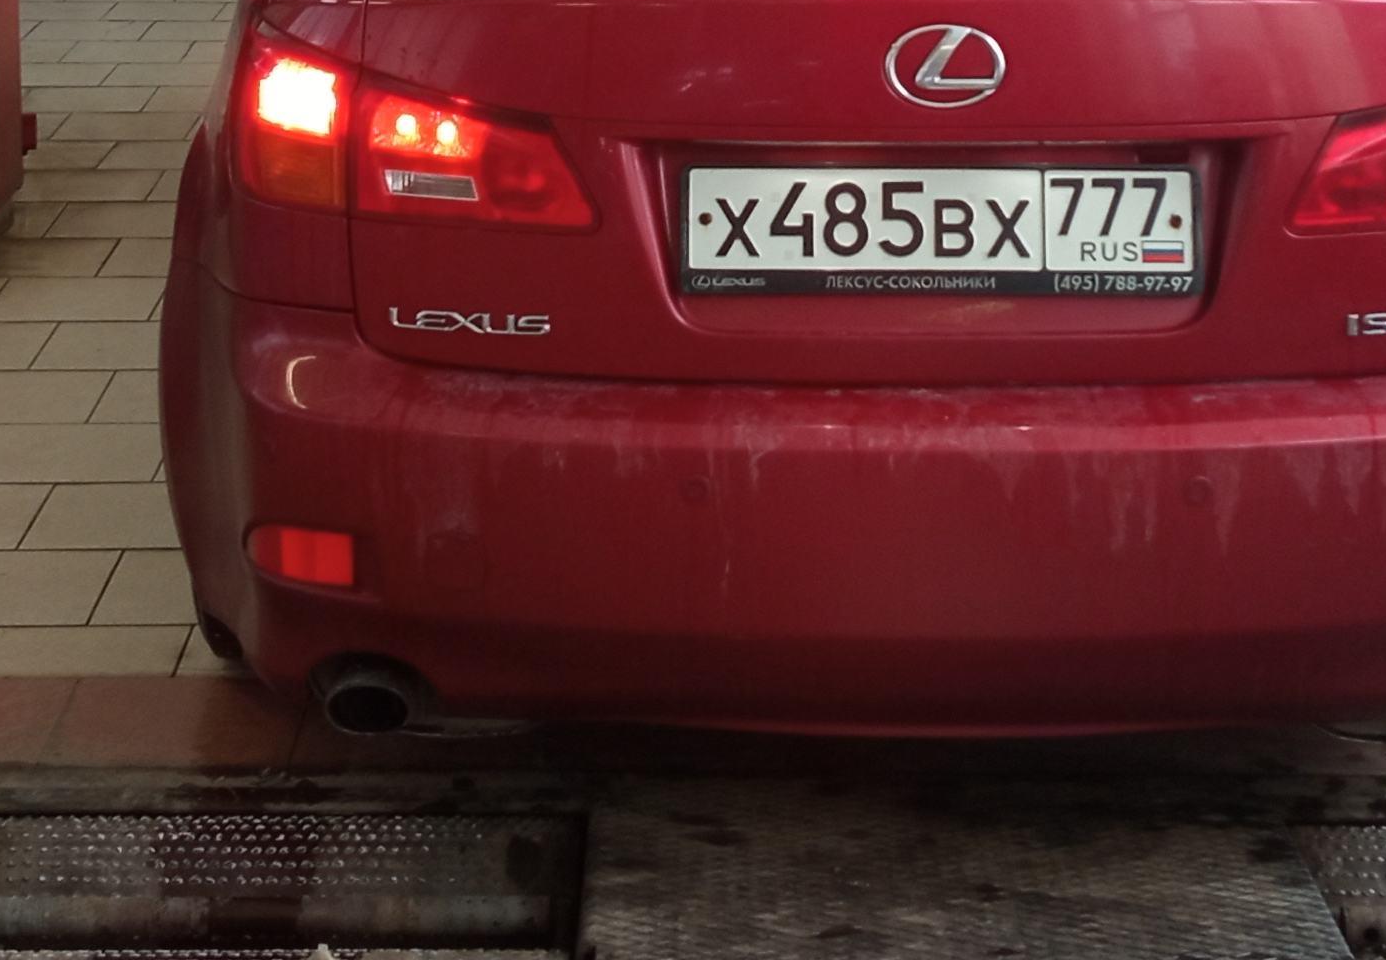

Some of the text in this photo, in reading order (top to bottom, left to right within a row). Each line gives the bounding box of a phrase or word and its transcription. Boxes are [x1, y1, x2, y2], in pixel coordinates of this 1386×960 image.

[1049, 177, 1168, 237] 777
[1080, 241, 1139, 262] RUS
[825, 275, 996, 290] ЛЕКСУС-СОКОЛЬНИКИ
[1054, 274, 1194, 292] (495) 788-97-97
[389, 307, 551, 335] LEXUS
